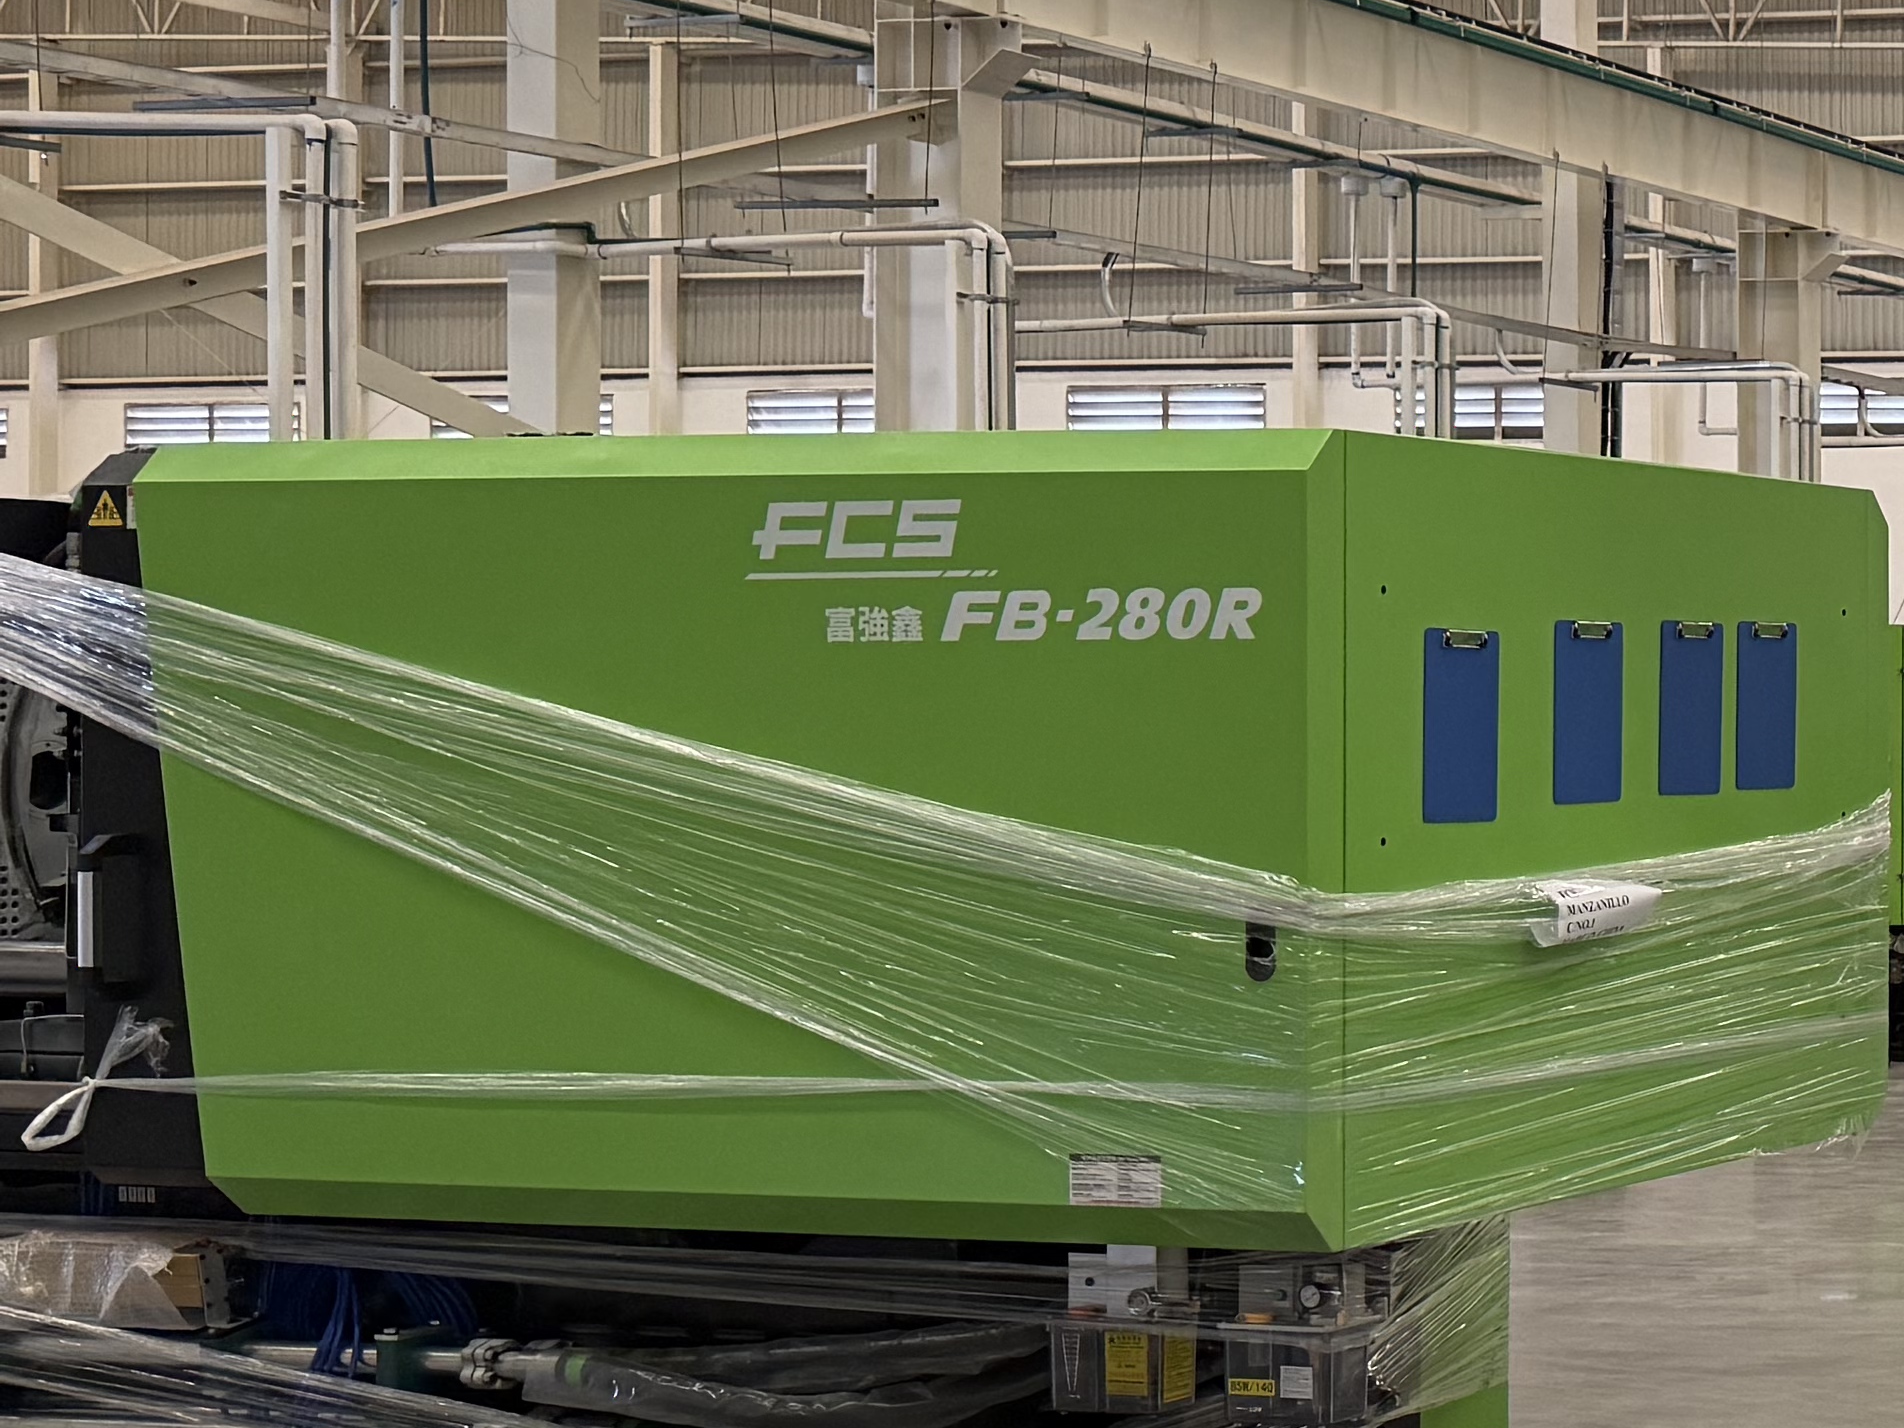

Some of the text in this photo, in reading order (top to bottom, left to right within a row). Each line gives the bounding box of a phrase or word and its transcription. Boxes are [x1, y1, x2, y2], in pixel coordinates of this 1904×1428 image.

[751, 498, 962, 560] FCS
[824, 606, 924, 644] 富強鑫
[940, 586, 1263, 642] FB-280R
[1566, 895, 1630, 915] MANZANILLO
